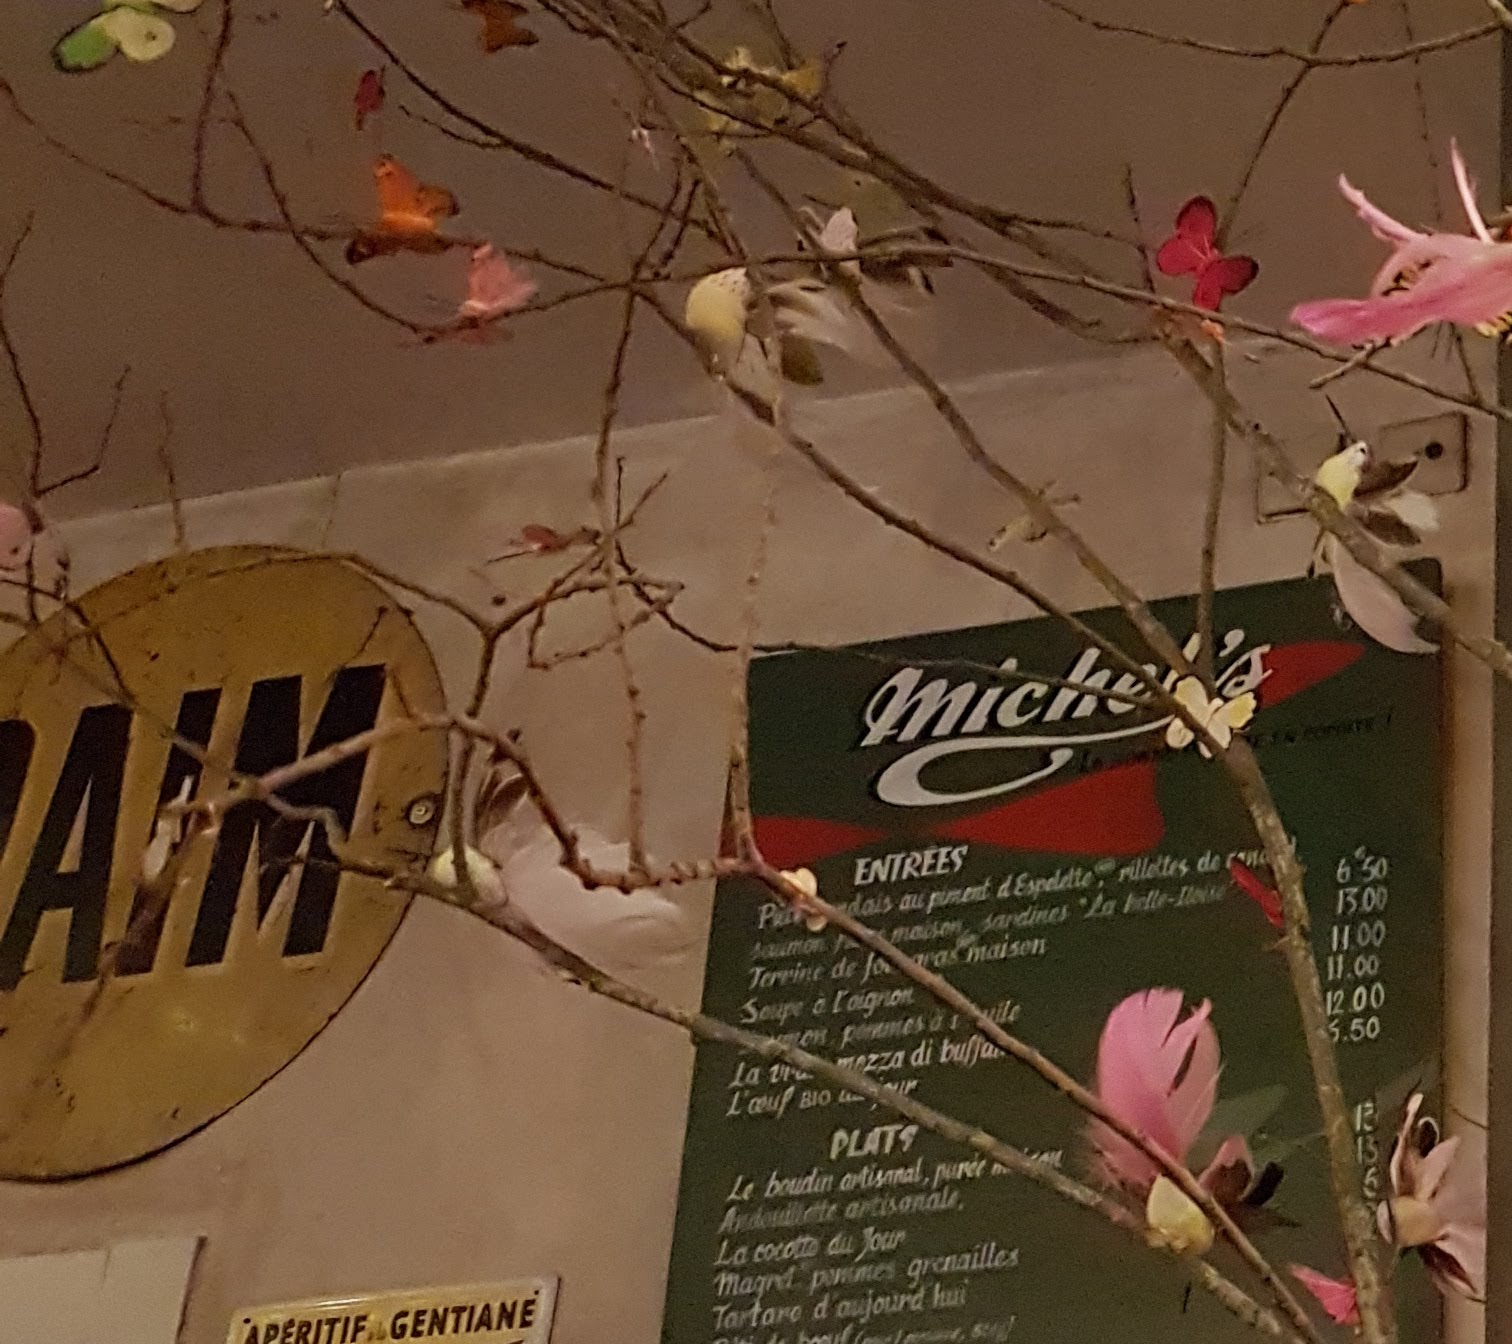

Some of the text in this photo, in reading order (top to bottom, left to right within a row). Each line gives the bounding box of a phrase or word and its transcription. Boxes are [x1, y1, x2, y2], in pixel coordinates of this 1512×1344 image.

[965, 934, 1047, 964] maison
[1325, 981, 1385, 1016] 12.00
[728, 1060, 761, 1089] La
[829, 1124, 921, 1162] PLATS
[725, 1173, 755, 1202] Le
[763, 1166, 835, 1199] boudin
[713, 1238, 748, 1266] La
[828, 1231, 854, 1257] du
[390, 1297, 536, 1341] GENTIANE
